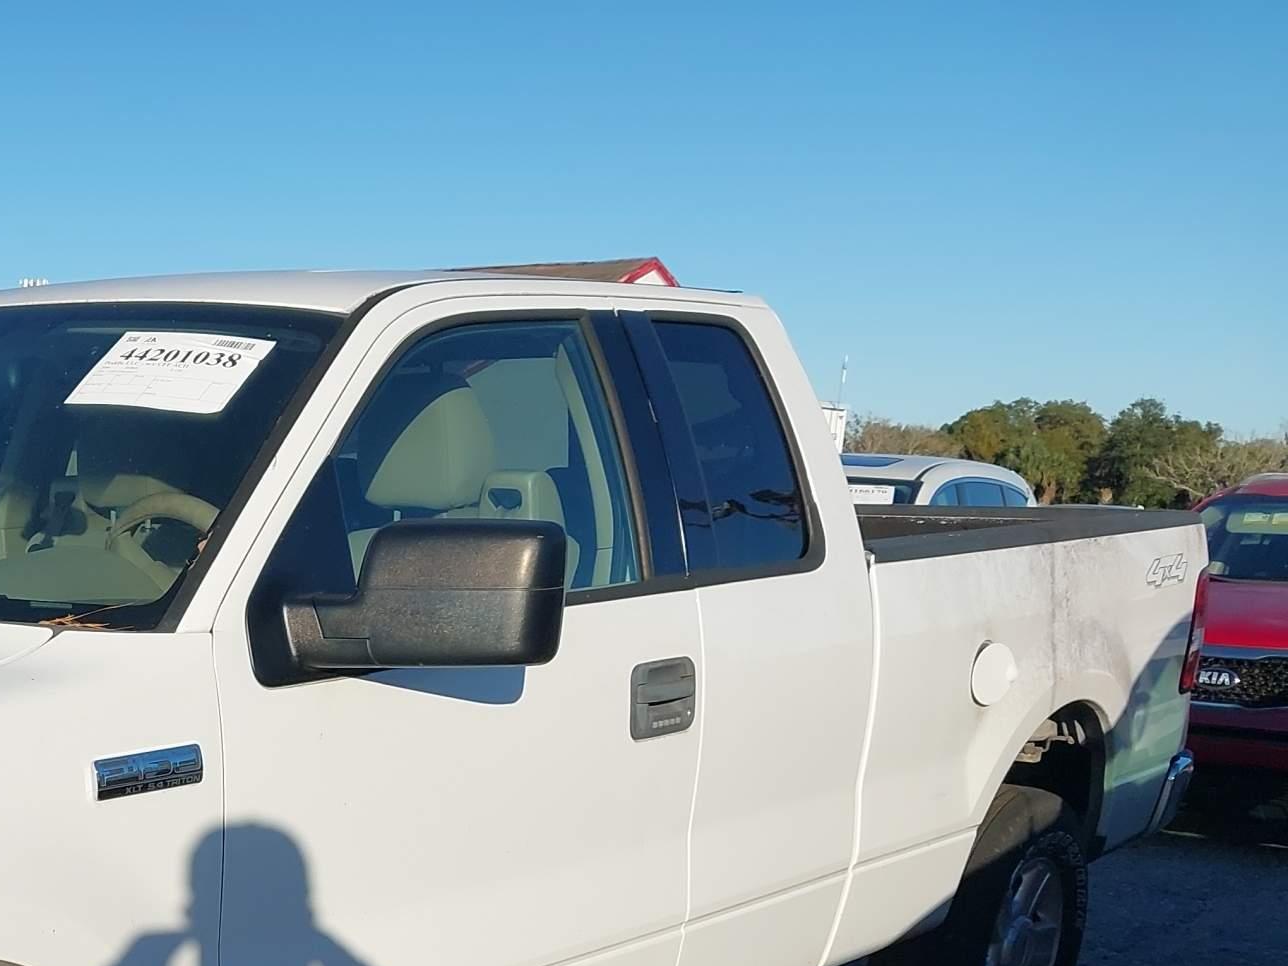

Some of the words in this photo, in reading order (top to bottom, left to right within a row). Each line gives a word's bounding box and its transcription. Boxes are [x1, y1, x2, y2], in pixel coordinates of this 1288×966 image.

[120, 347, 242, 369] 44201038
[1145, 553, 1188, 589] 4x4
[1198, 671, 1231, 686] KIA
[167, 775, 201, 788] TRITON
